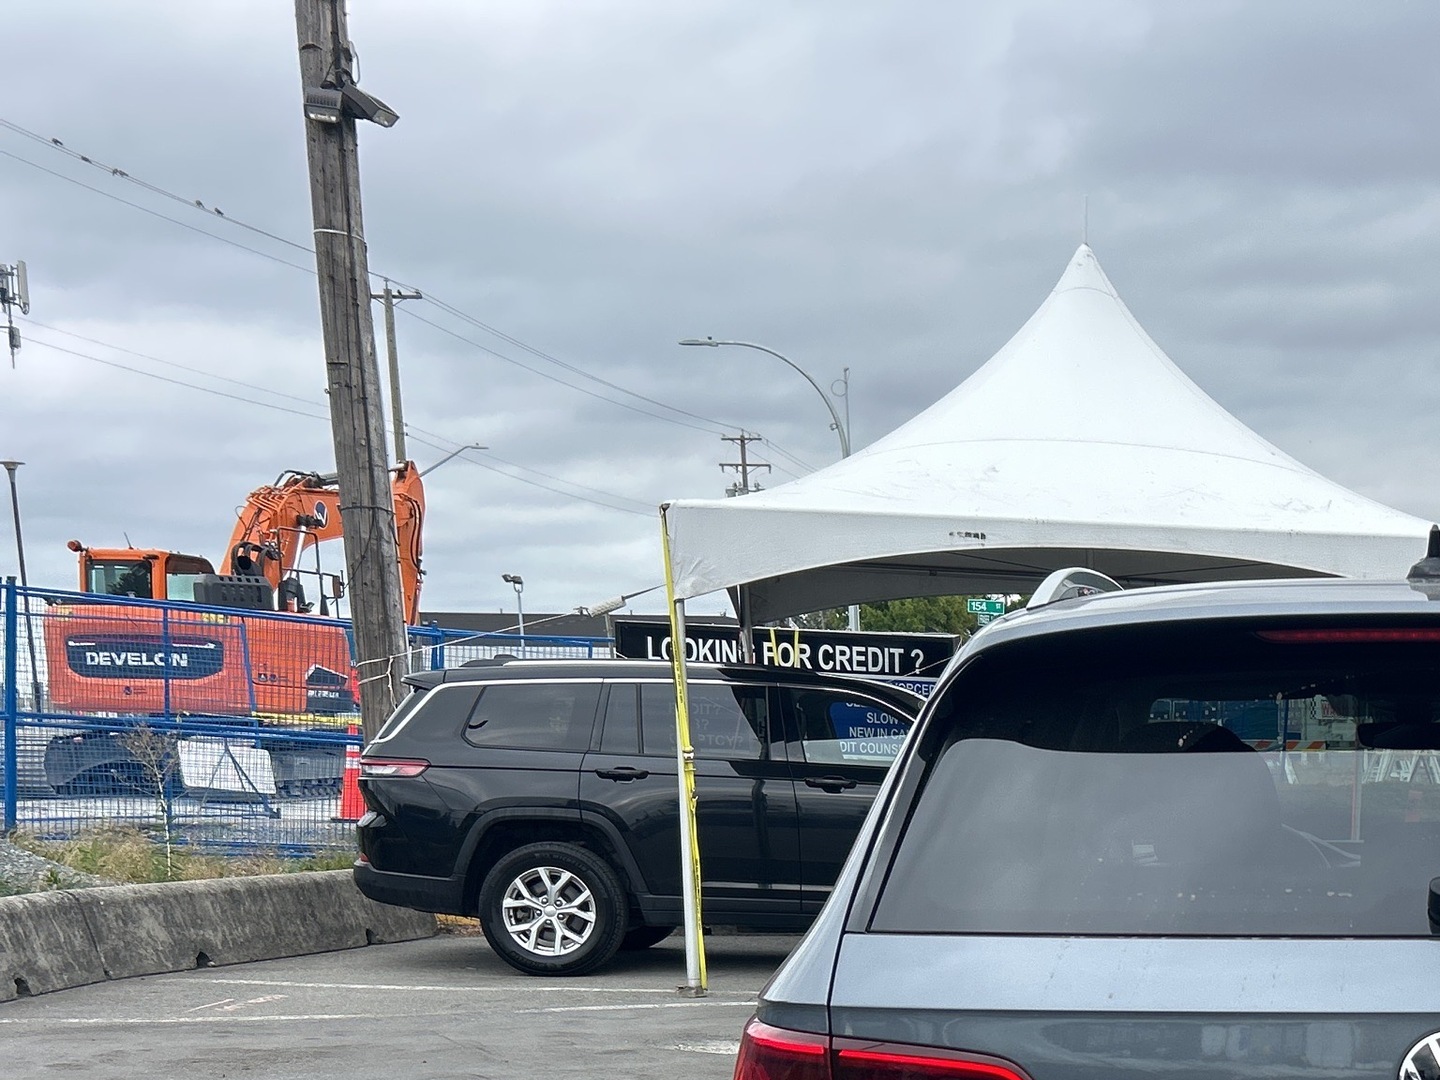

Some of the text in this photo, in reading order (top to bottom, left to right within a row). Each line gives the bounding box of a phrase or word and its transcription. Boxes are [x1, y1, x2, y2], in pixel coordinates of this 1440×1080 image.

[971, 601, 987, 611] 154
[763, 641, 812, 669] FOR
[818, 645, 904, 674] CREDIT
[849, 726, 874, 738] NEW
[877, 728, 888, 739] IN
